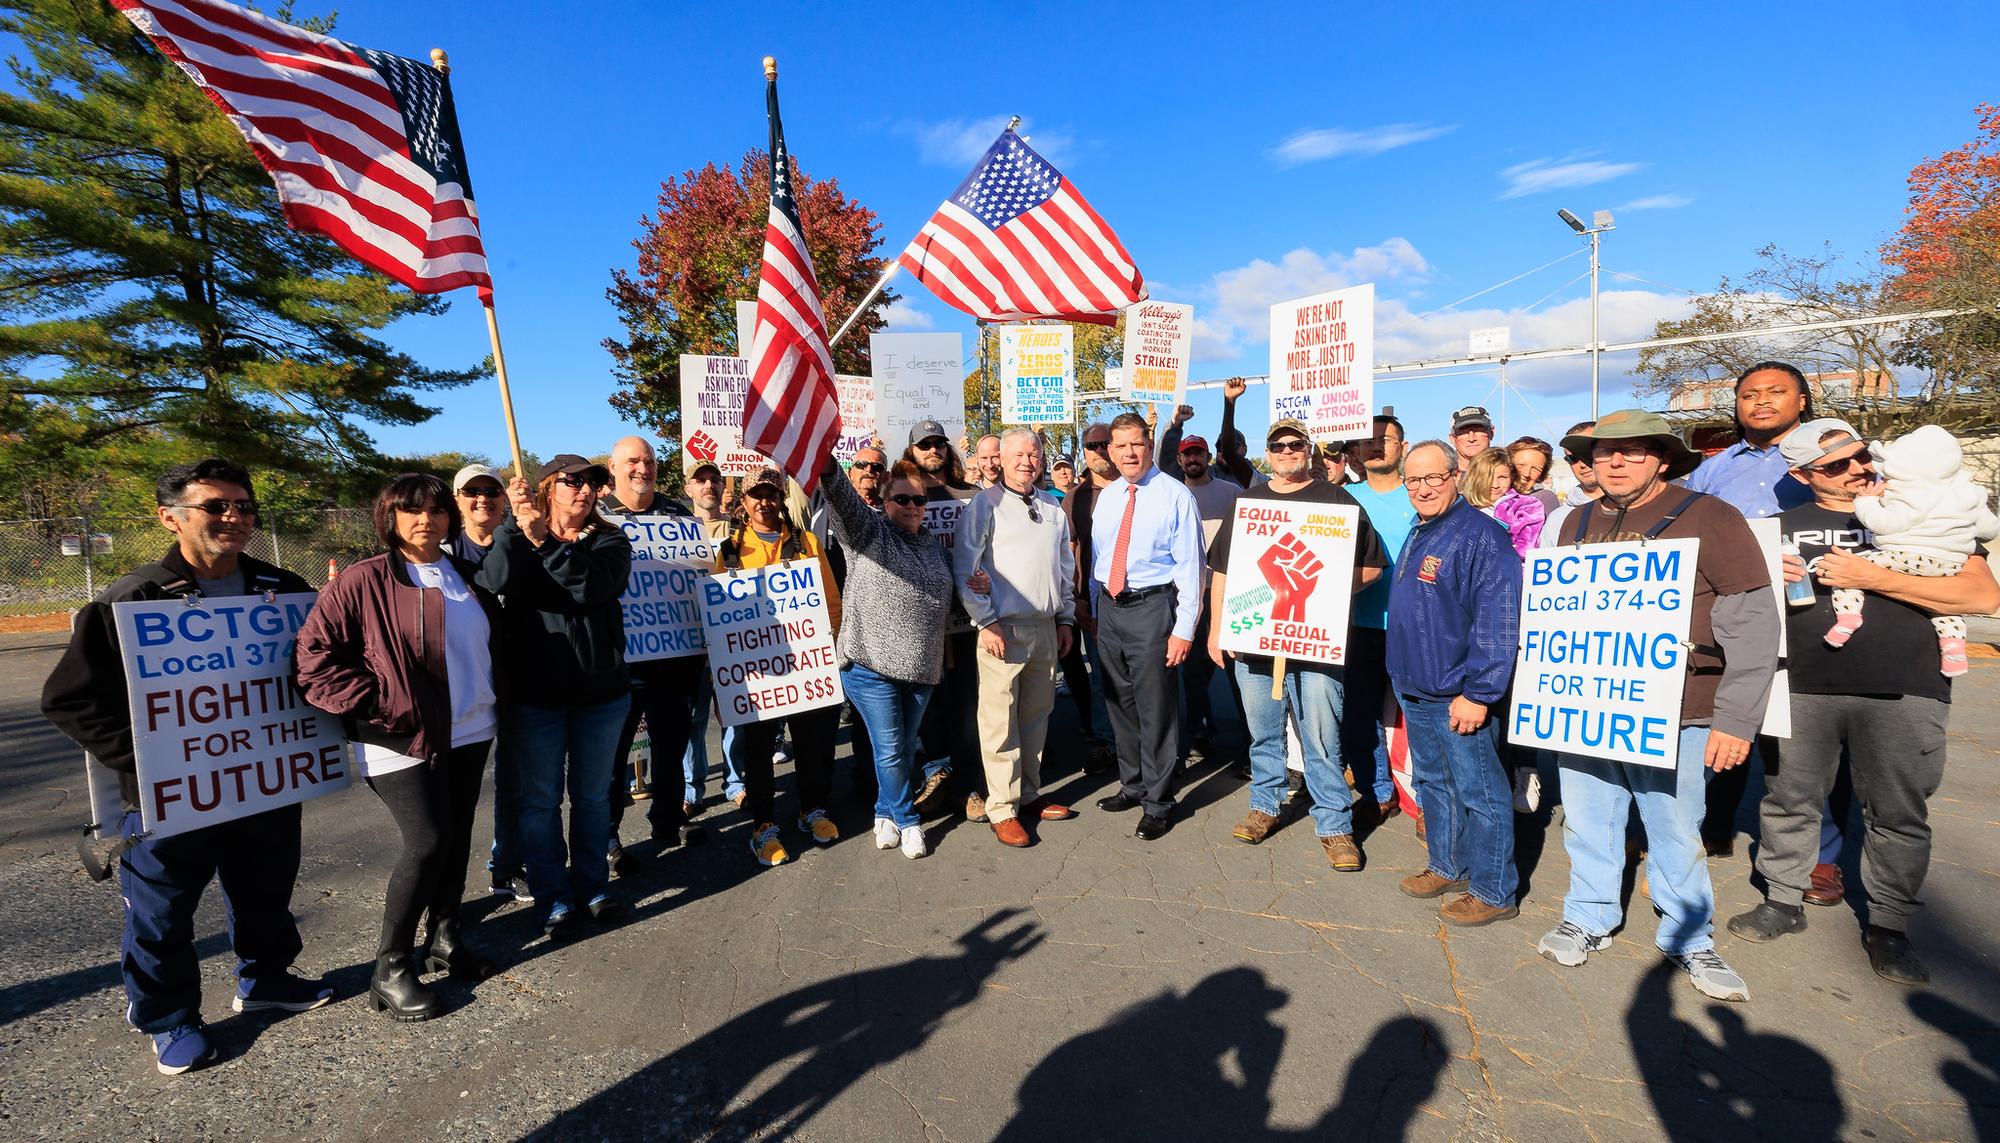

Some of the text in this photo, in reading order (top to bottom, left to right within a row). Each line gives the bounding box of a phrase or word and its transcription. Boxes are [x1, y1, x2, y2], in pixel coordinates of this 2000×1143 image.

[1139, 304, 1183, 323] Kellogg's
[1296, 300, 1343, 327] WE'RE NOT
[1137, 329, 1163, 337] COATING
[1141, 321, 1178, 331] ISN'T SUGAR
[1294, 321, 1347, 349] ASKING FOR
[1019, 332, 1063, 347] HEROES
[1142, 346, 1172, 354] WORKERS
[1318, 345, 1341, 366] JUST
[1342, 342, 1355, 363] TO
[707, 357, 749, 375] WE'RE NOT
[883, 352, 959, 369] I deserve
[1019, 353, 1063, 368] ZEROS
[1135, 354, 1179, 368] STRIKE!!
[705, 376, 735, 392] ASKING
[1017, 376, 1063, 387] BCTGM
[1290, 365, 1350, 392] ALL BE EQUAL!
[728, 394, 746, 409] JUST
[884, 383, 924, 404] Equal
[928, 385, 951, 407] Pay
[1275, 395, 1311, 410] BCTGM
[1322, 389, 1359, 405] UNION
[913, 401, 930, 409] and
[1045, 405, 1064, 413] AND
[1316, 403, 1366, 420] STRONG
[702, 410, 715, 426] ALL
[717, 411, 727, 426] BE
[1278, 409, 1308, 421] LOCAL
[1310, 421, 1368, 435] SOLIDARITY
[726, 453, 764, 463] UNION
[1238, 507, 1292, 523] EQUAL
[1306, 513, 1346, 527] UNION
[620, 522, 702, 543] CTGM
[1246, 522, 1280, 537] PAY
[1299, 525, 1351, 539] STRONG
[630, 546, 653, 561] cal
[660, 545, 708, 560] 374-G
[1532, 551, 1681, 586] BCTGM
[703, 566, 815, 607] BCTGM
[1527, 588, 1680, 612] Local 374-G
[623, 600, 702, 628] ESSENTI
[706, 592, 821, 627] Local 374-G
[726, 618, 815, 654] FIGHTING
[1273, 622, 1330, 642] EQUAL
[1258, 636, 1342, 661] BENEFITS
[1525, 630, 1678, 670] FIGHTING
[136, 646, 236, 679] Local
[717, 645, 834, 688] CORPORATE
[734, 676, 835, 715] GREED $$$
[1538, 673, 1646, 702] FOR THE
[146, 674, 310, 732] FIGHTIN
[182, 716, 318, 762] FOR THE
[1515, 703, 1668, 757] FUTURE
[153, 745, 344, 822] FUTURE
